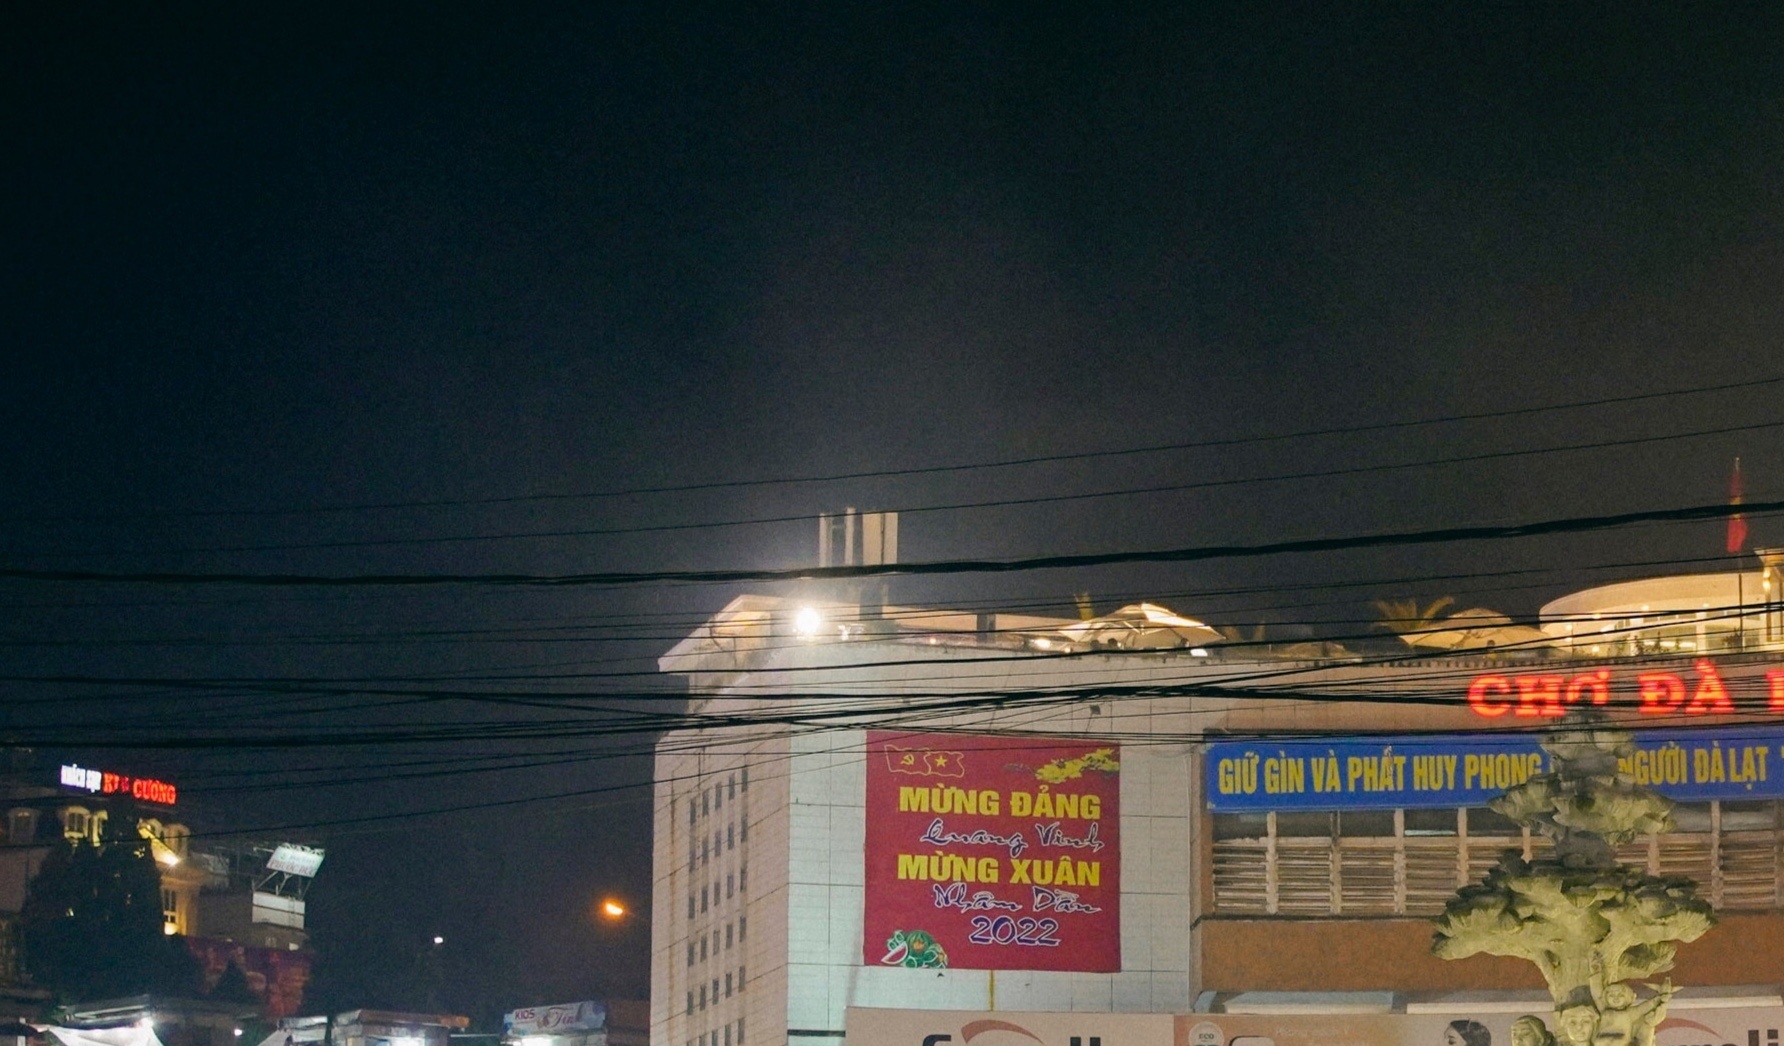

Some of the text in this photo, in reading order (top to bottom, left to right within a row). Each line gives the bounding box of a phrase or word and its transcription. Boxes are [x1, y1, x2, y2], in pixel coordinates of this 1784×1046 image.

[1637, 659, 1735, 715] ĐÀ
[1264, 749, 1304, 794] GÌN
[1311, 748, 1341, 792] VÀ
[1413, 754, 1457, 791] HUY
[1729, 745, 1768, 790] LẠT
[899, 782, 1101, 820] MỪNG ĐẢNG
[920, 818, 1105, 858] Quang Vinh
[897, 850, 1101, 887] MỪNG XUÂN
[969, 914, 1061, 946] 2022
